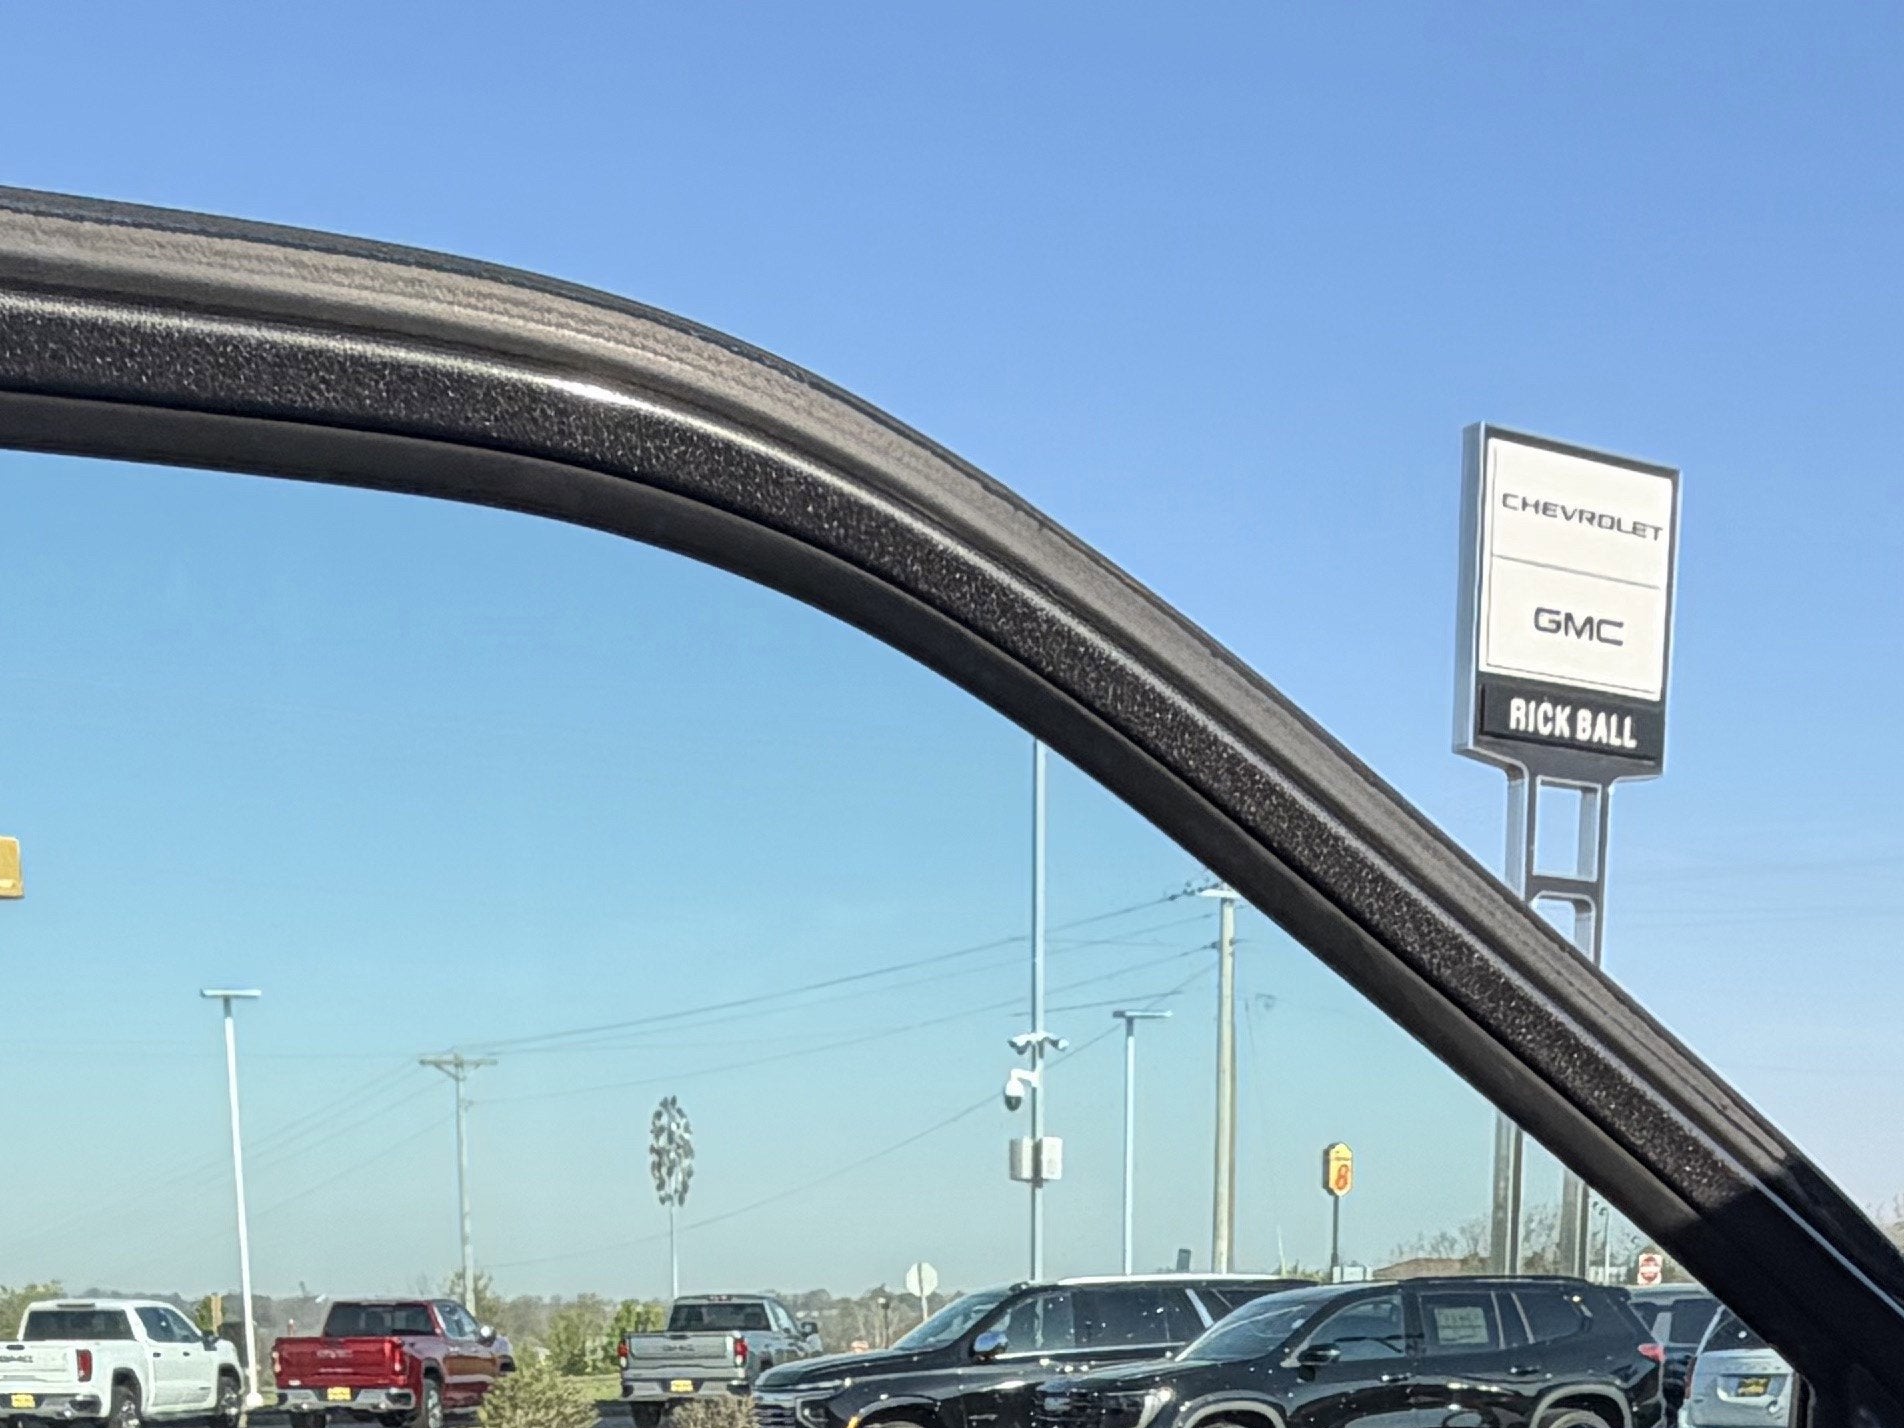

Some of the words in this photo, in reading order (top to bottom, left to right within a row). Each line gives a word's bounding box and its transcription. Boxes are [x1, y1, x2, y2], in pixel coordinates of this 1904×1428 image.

[1502, 492, 1664, 542] CHEVROLET
[1533, 606, 1624, 647] GMC
[1508, 697, 1571, 739] RICK
[1575, 711, 1638, 749] BALL
